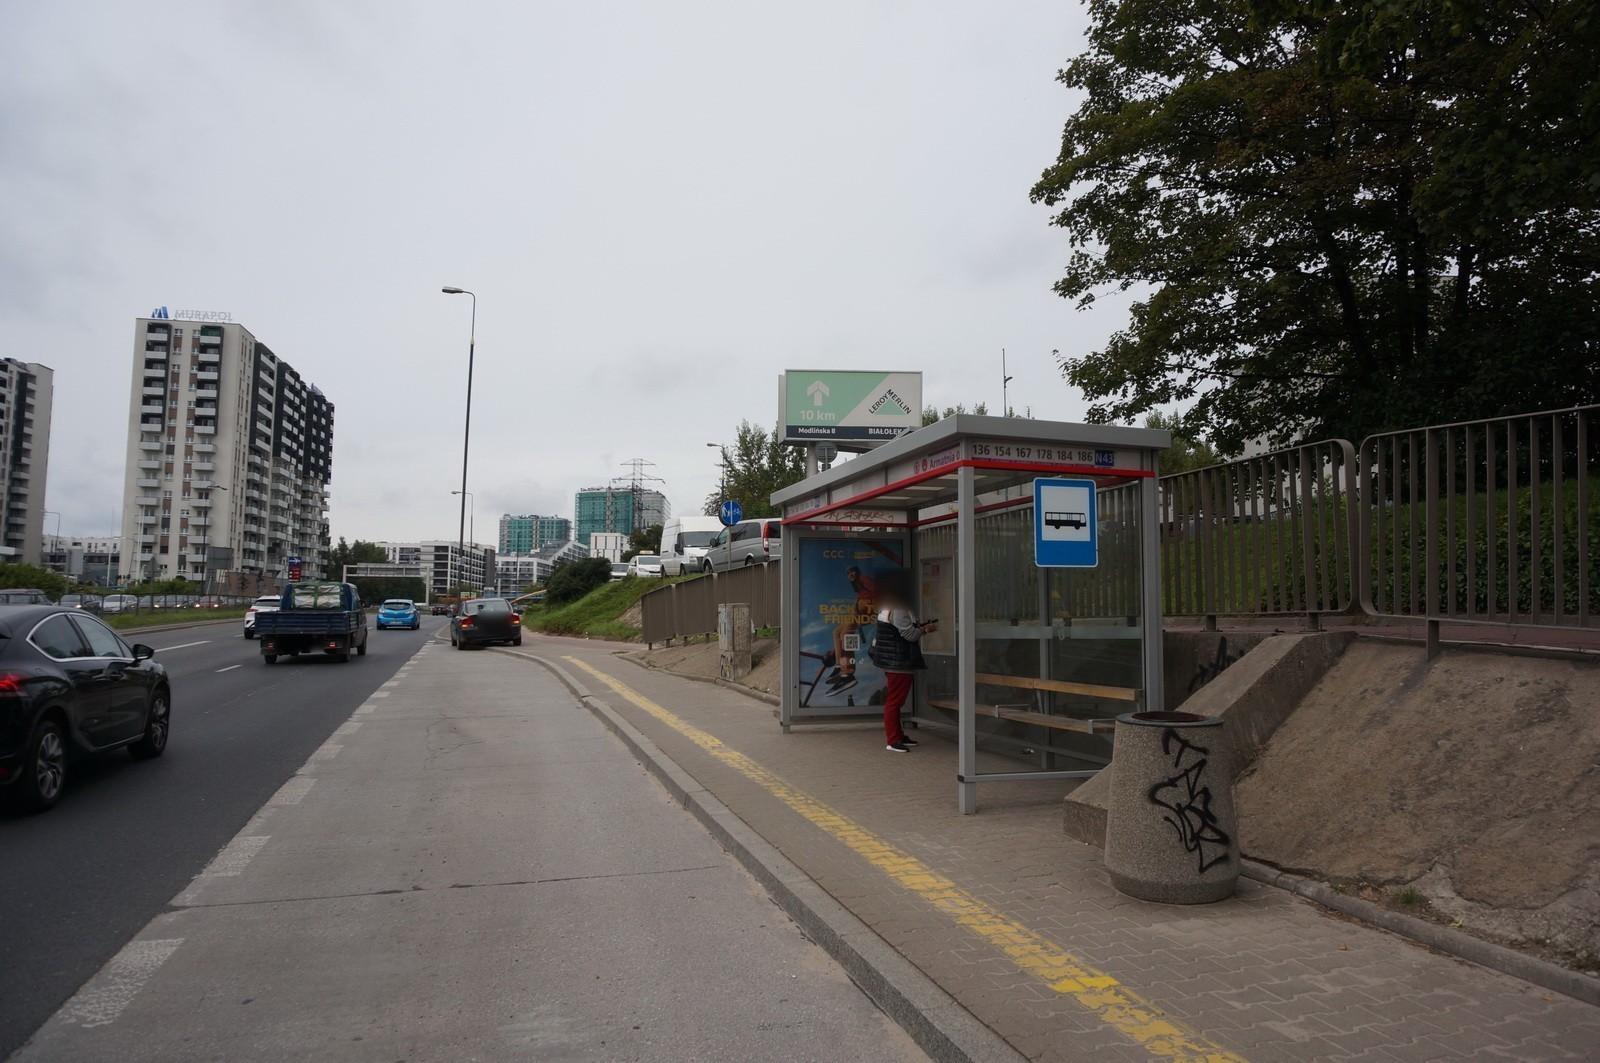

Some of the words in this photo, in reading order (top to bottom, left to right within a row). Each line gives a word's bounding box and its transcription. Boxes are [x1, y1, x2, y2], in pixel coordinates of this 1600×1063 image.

[175, 309, 233, 321] MURAPOL
[868, 393, 888, 414] LEROY
[886, 388, 912, 415] MERLIN
[800, 410, 814, 421] 10
[817, 410, 836, 421] km
[868, 427, 904, 436] BIAŁOŁEK
[972, 444, 990, 455] 136
[994, 446, 1011, 457] 154
[1016, 447, 1032, 458] 167
[1037, 448, 1053, 460] 178
[1057, 450, 1073, 461] 184
[1078, 451, 1093, 462] 186
[1095, 451, 1113, 464] N43
[824, 614, 878, 625] FRIENDS
